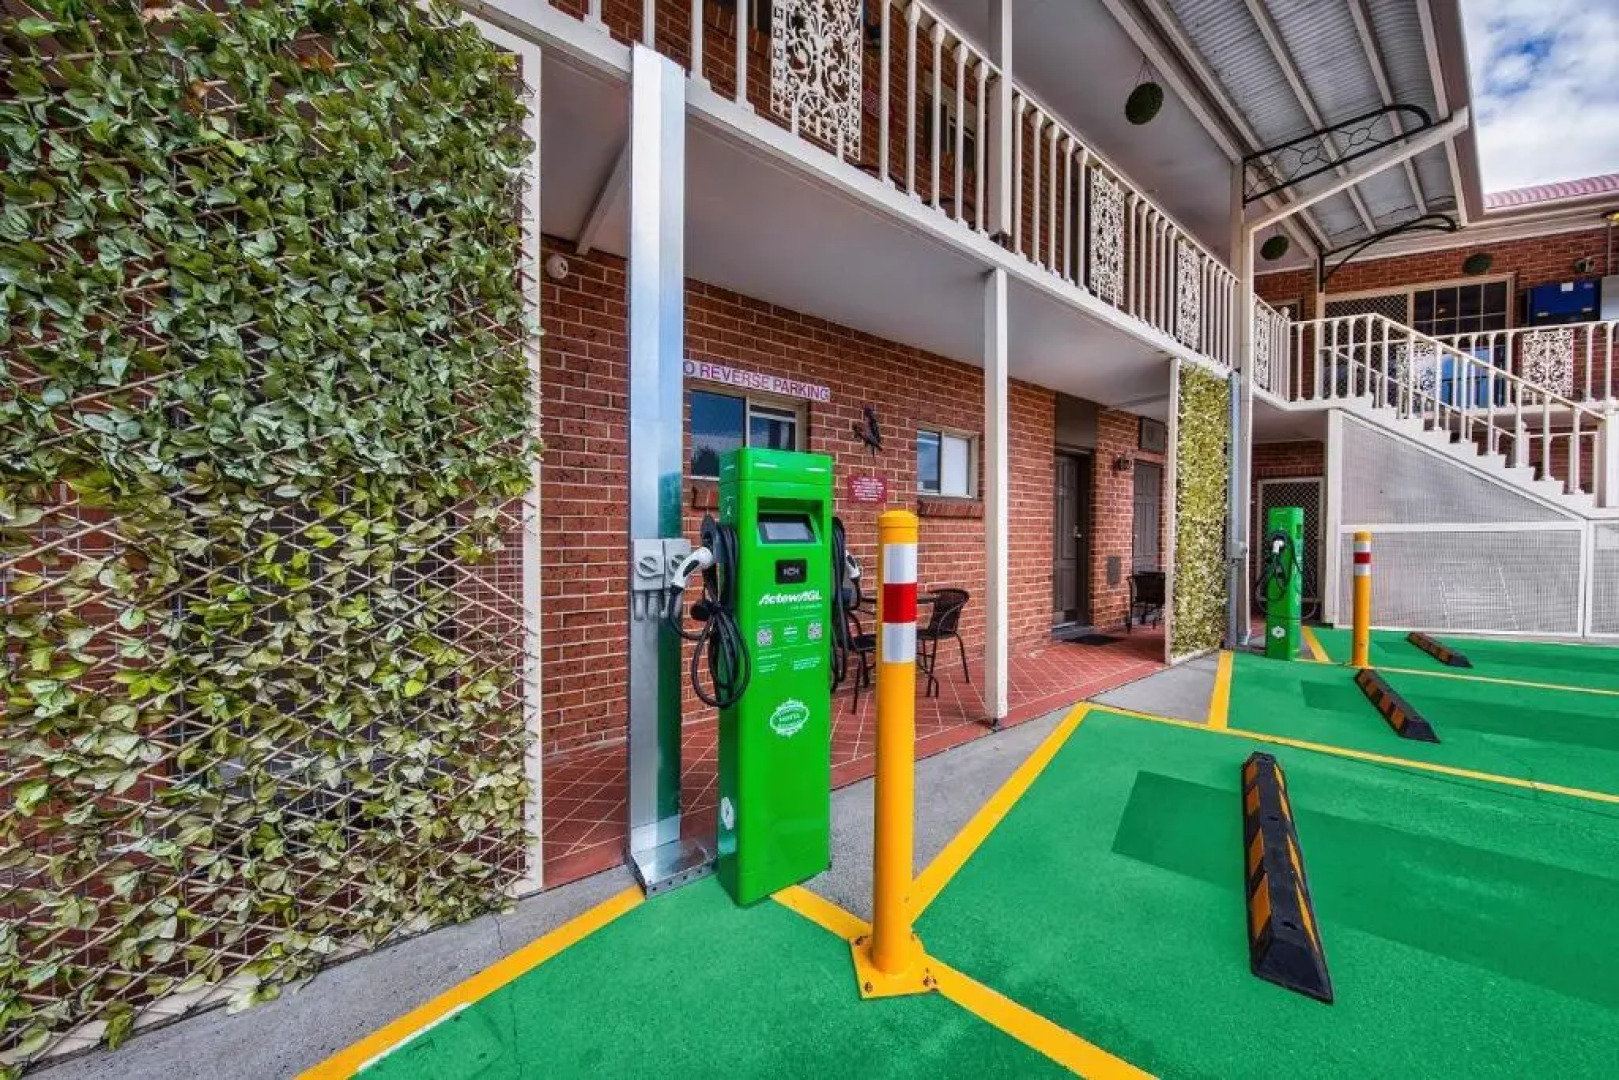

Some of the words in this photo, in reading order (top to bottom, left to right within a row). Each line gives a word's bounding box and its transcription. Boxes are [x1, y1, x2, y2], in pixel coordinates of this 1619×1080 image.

[683, 360, 695, 375] O
[699, 363, 771, 390] REVERSE
[772, 379, 829, 400] PARKING
